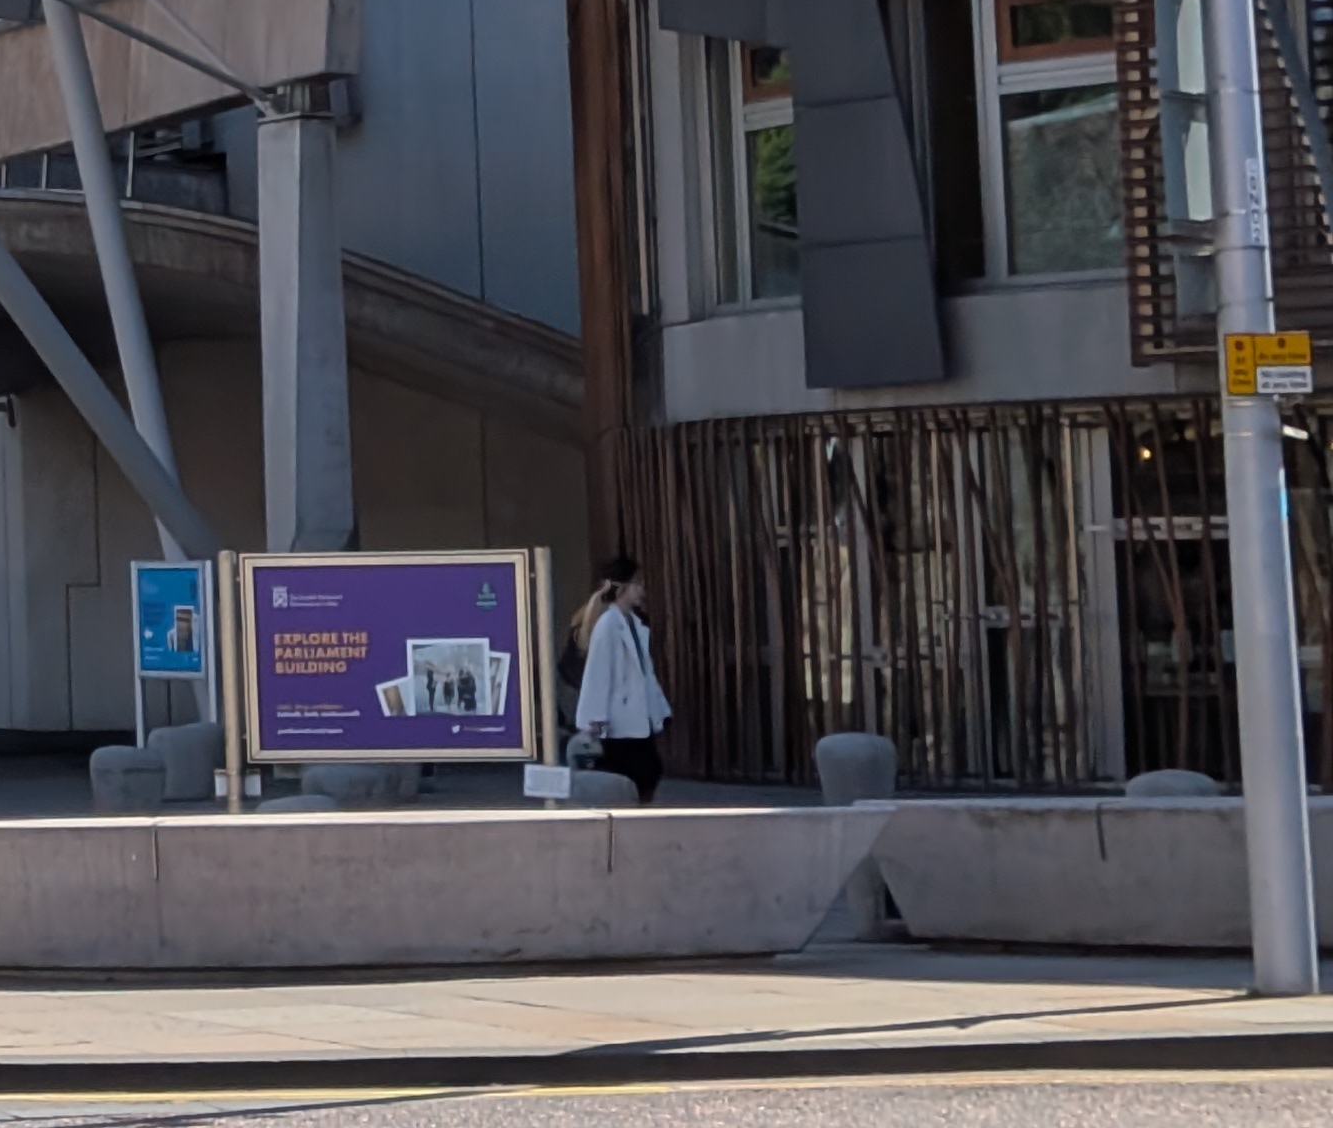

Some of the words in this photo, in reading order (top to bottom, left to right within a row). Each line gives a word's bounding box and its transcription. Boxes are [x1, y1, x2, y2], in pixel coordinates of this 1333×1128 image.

[274, 633, 337, 646] EXPLORE
[342, 632, 368, 644] THE
[274, 647, 368, 660] PARLIAMENT
[275, 661, 347, 674] BUILDING
